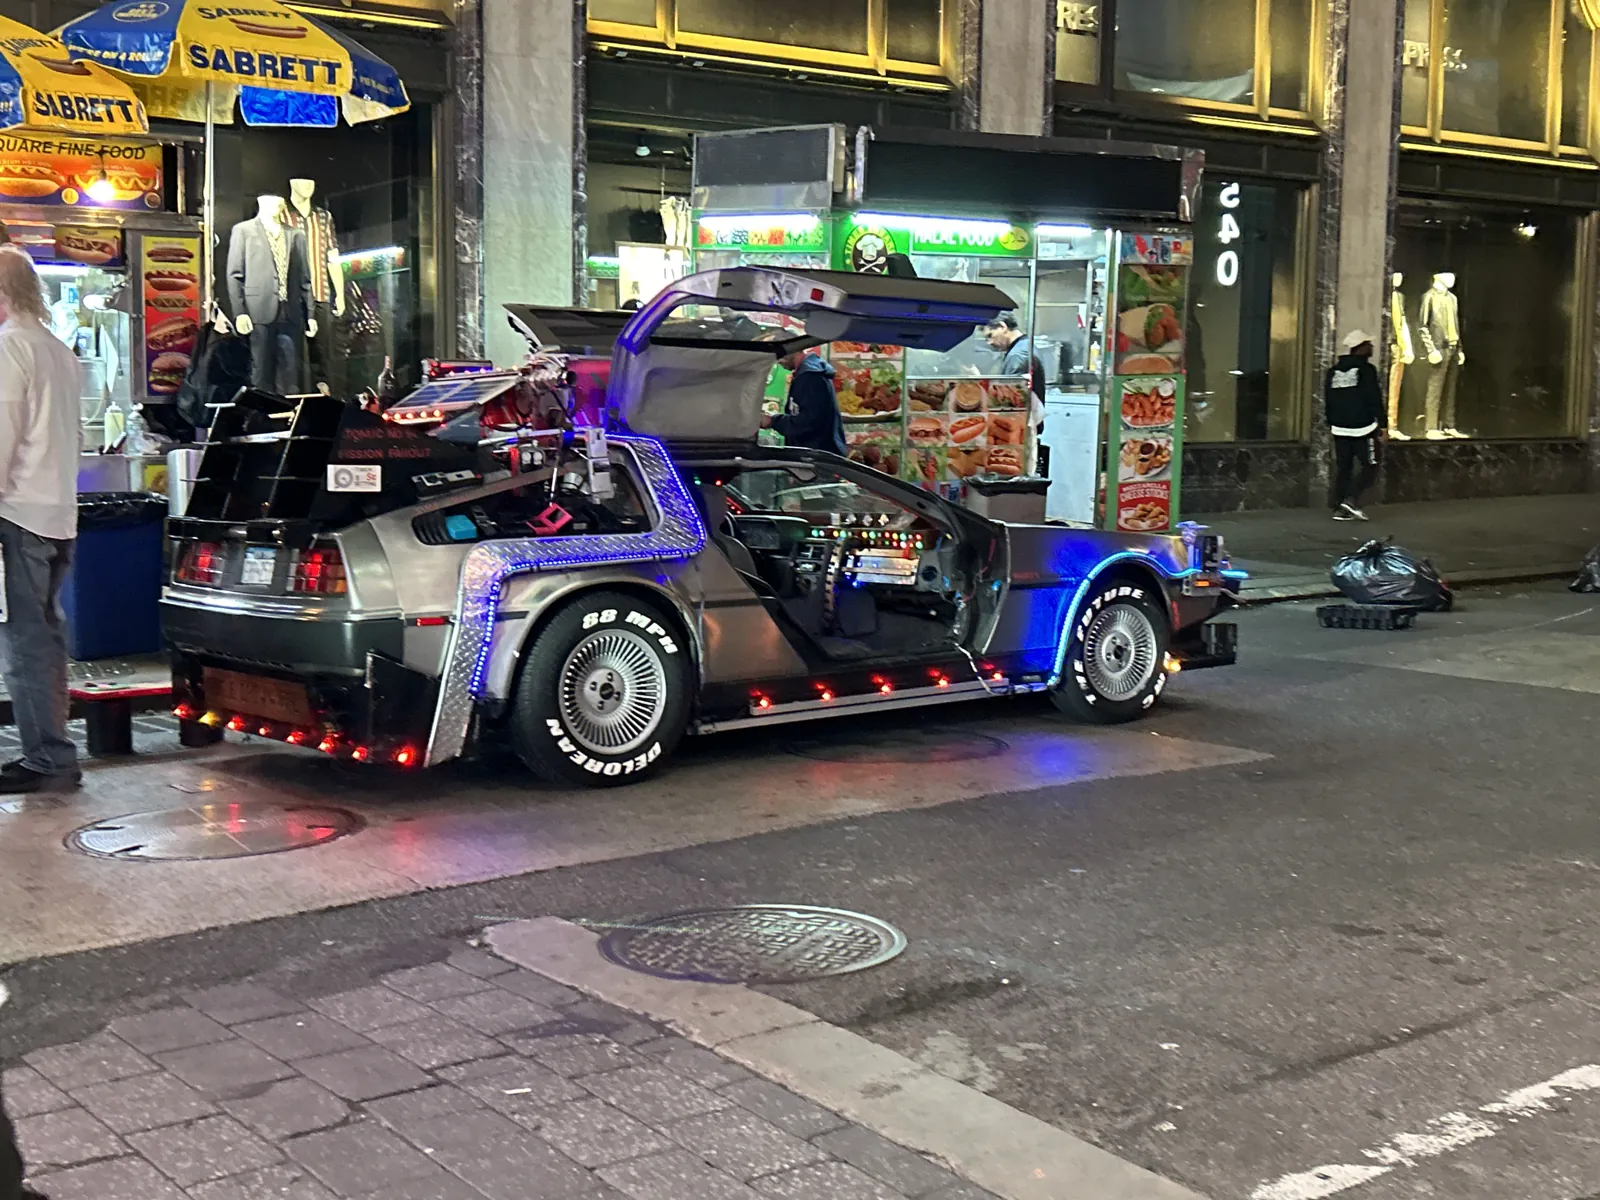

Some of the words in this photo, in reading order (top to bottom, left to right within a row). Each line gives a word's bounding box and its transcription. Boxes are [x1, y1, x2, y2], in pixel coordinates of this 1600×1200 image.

[197, 7, 291, 20] SABRETT
[189, 43, 343, 85] SABRETT
[33, 91, 134, 123] SABRETT
[58, 142, 95, 157] FINE
[101, 144, 146, 160] FOOD
[912, 229, 957, 246] HALAL
[959, 230, 995, 247] FOOD
[582, 609, 618, 629] 88
[625, 611, 678, 654] MPH
[1077, 586, 1145, 642] FUTURE
[546, 719, 662, 776] DELOREAN
